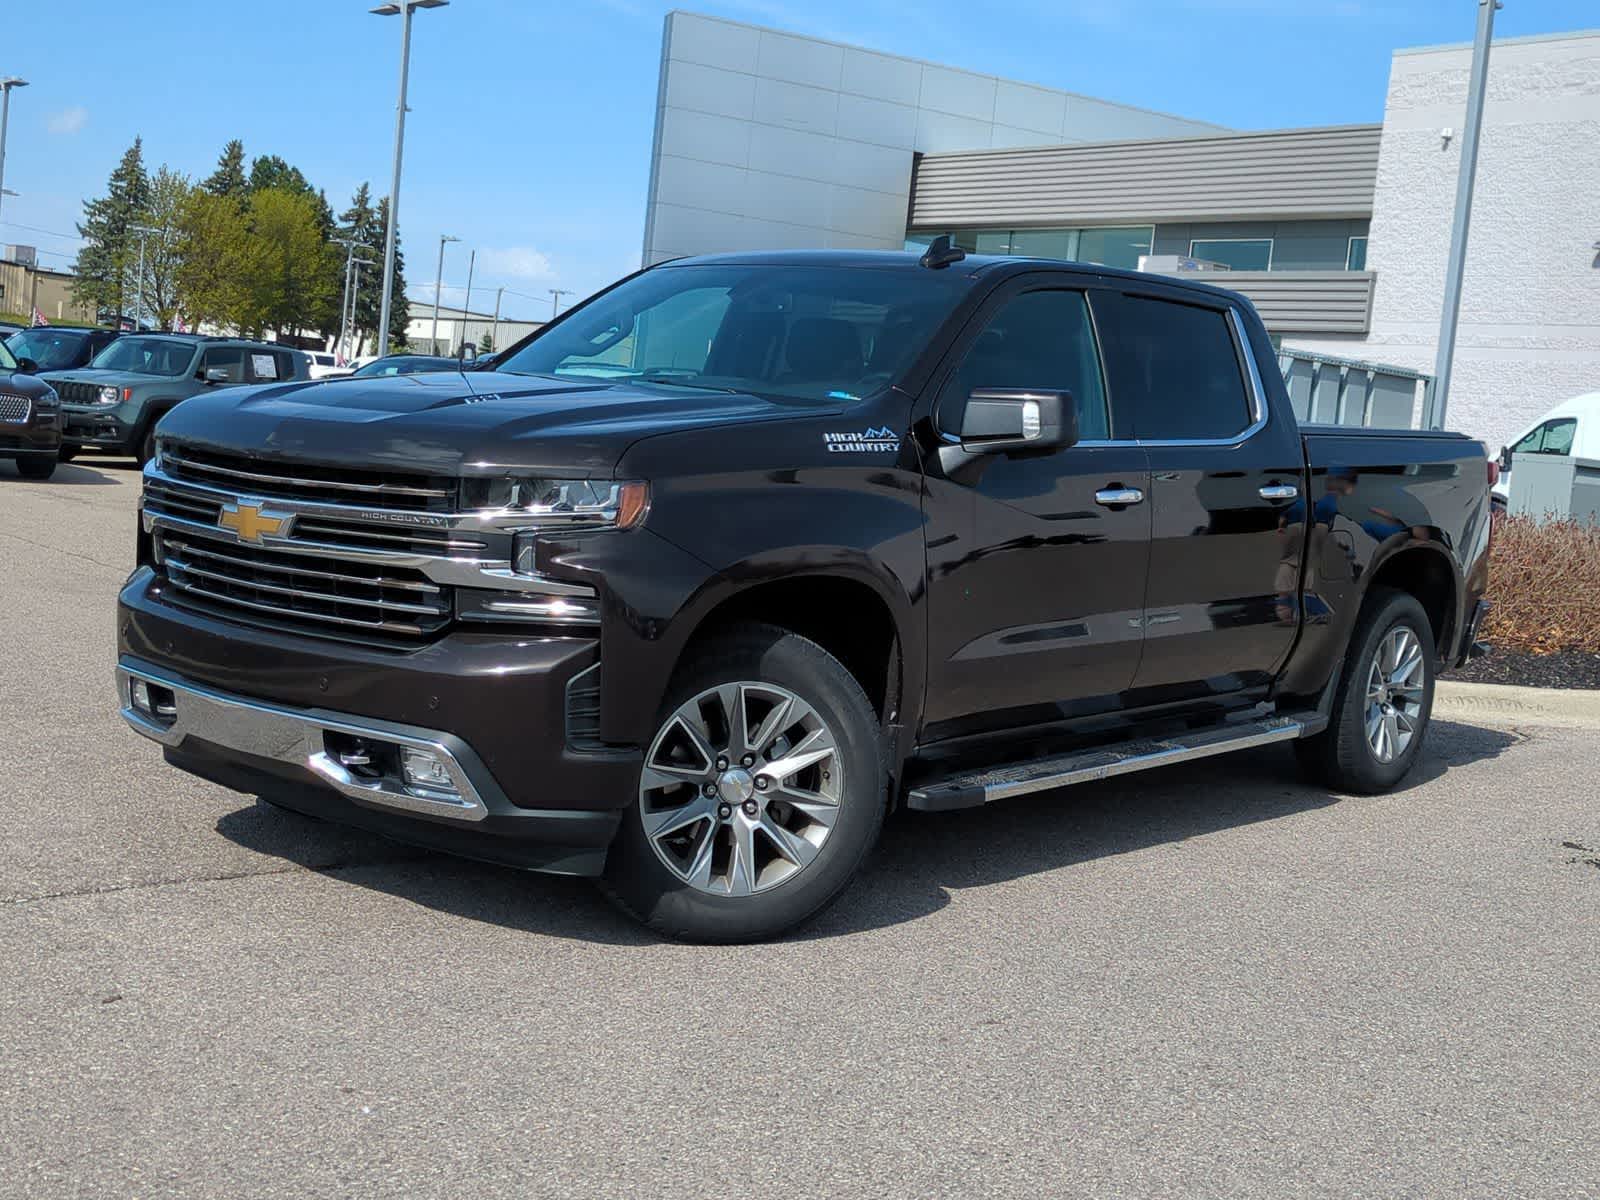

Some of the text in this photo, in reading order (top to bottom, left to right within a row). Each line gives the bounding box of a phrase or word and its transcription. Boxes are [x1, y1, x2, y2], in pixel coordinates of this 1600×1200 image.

[823, 432, 864, 442] HIGH
[827, 442, 900, 452] COUNTRY
[361, 512, 387, 520] HIGH
